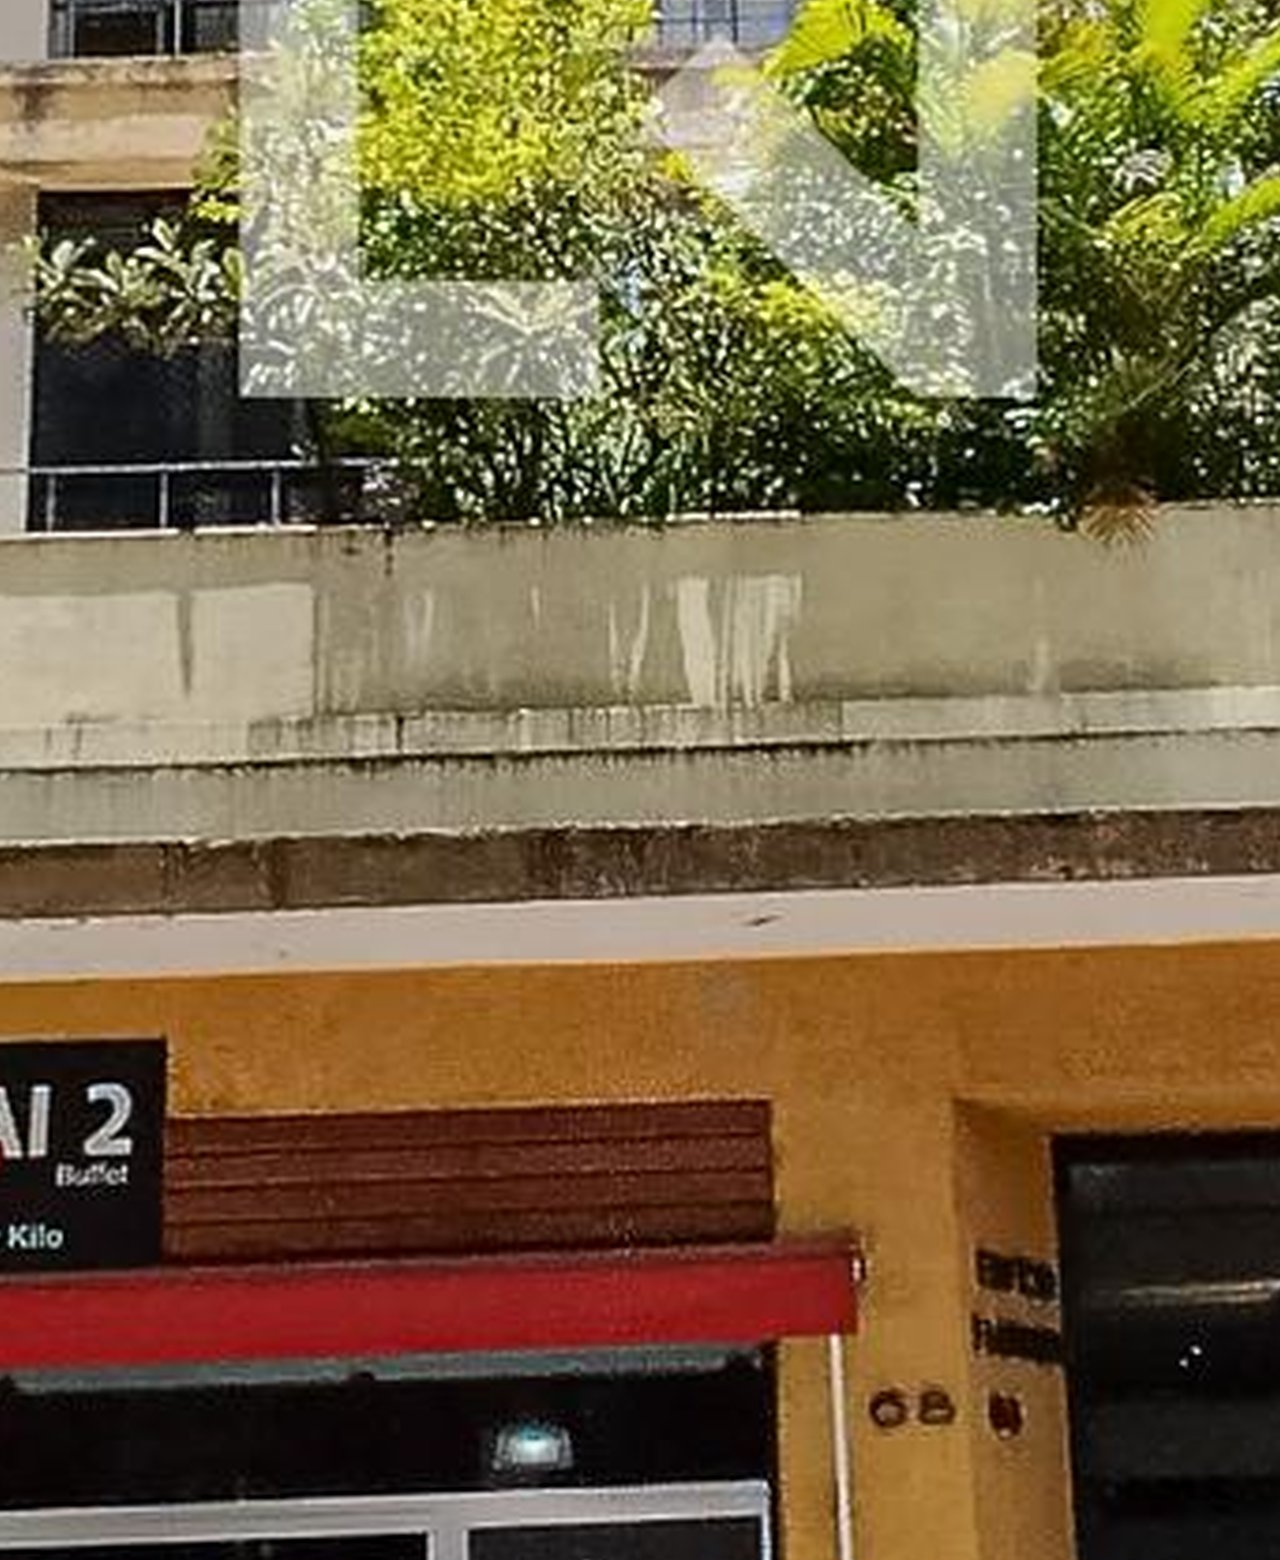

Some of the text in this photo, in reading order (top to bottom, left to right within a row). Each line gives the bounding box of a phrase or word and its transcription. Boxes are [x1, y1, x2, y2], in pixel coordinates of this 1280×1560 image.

[83, 1083, 132, 1158] 2
[56, 1163, 129, 1187] Buffet
[8, 1223, 63, 1251] Kilo
